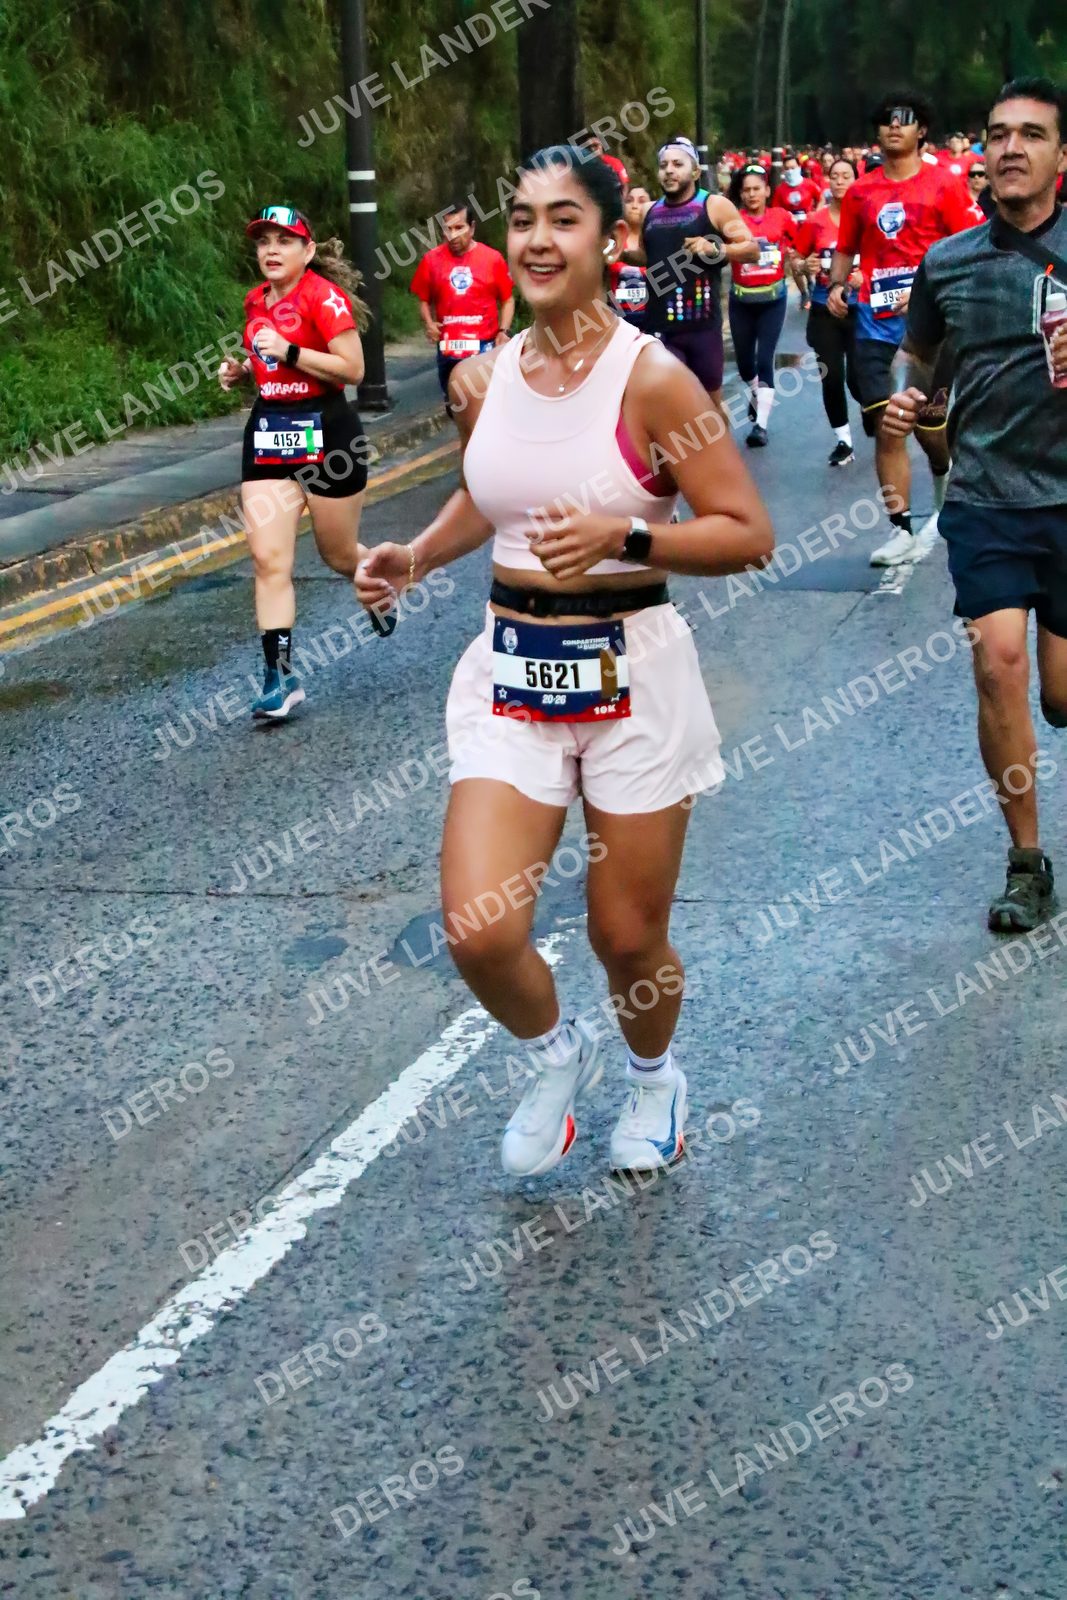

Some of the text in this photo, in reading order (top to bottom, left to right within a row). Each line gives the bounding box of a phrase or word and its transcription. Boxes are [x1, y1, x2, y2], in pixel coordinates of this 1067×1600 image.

[273, 433, 301, 447] 4152
[525, 660, 581, 690] 5621
[594, 704, 616, 715] 10K
